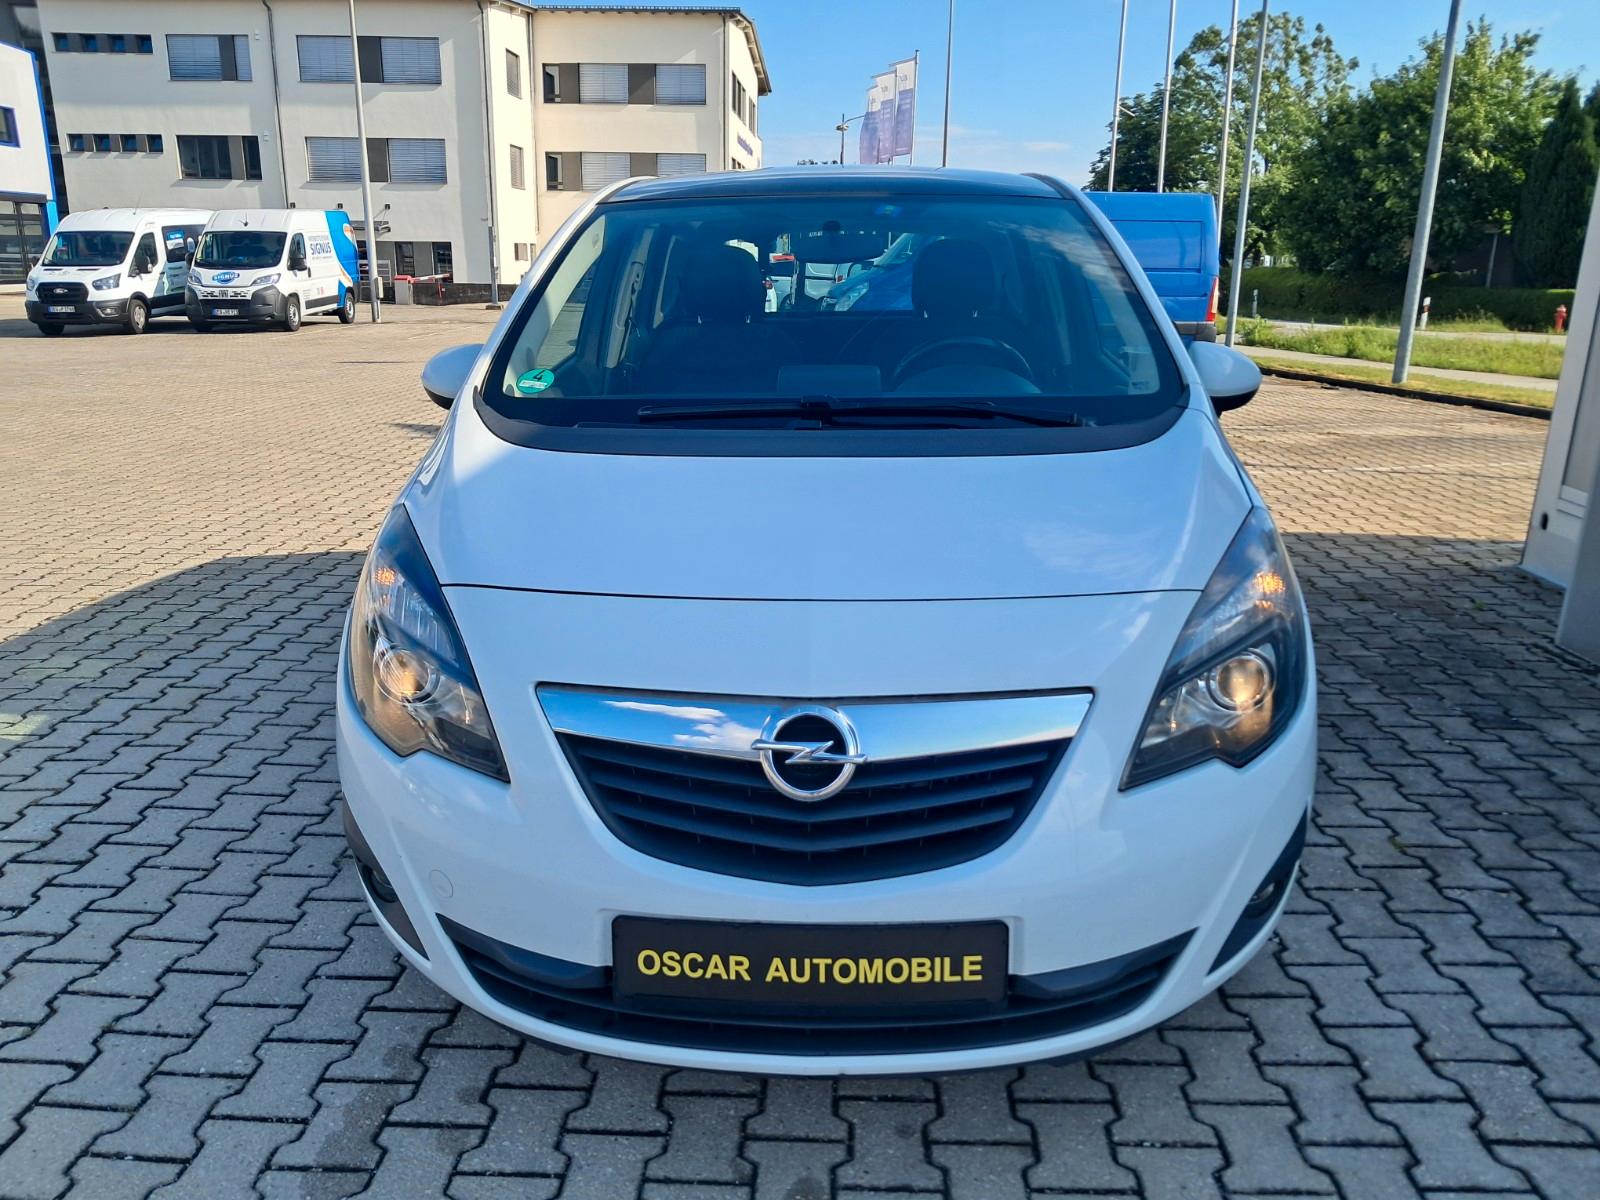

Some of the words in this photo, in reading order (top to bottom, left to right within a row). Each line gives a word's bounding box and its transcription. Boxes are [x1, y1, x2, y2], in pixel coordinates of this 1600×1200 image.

[310, 242, 331, 255] SIGNUS
[637, 949, 751, 981] OSCAR
[765, 955, 983, 984] AUTOMOBILE
